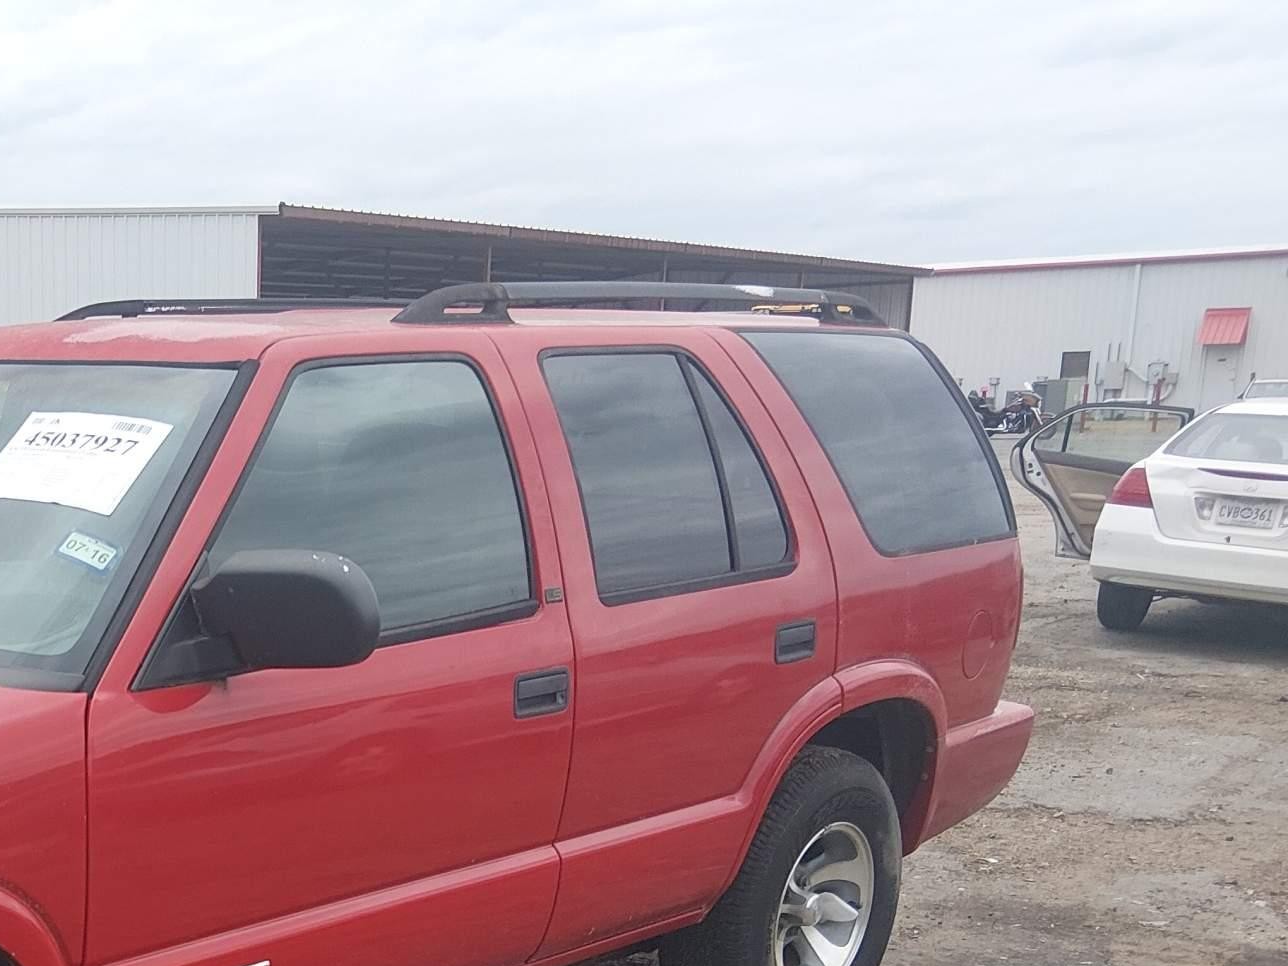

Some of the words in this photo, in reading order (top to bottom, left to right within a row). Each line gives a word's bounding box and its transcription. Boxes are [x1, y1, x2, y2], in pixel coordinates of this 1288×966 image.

[24, 431, 139, 455] 45037927
[65, 539, 87, 552] 07
[91, 549, 110, 564] 16
